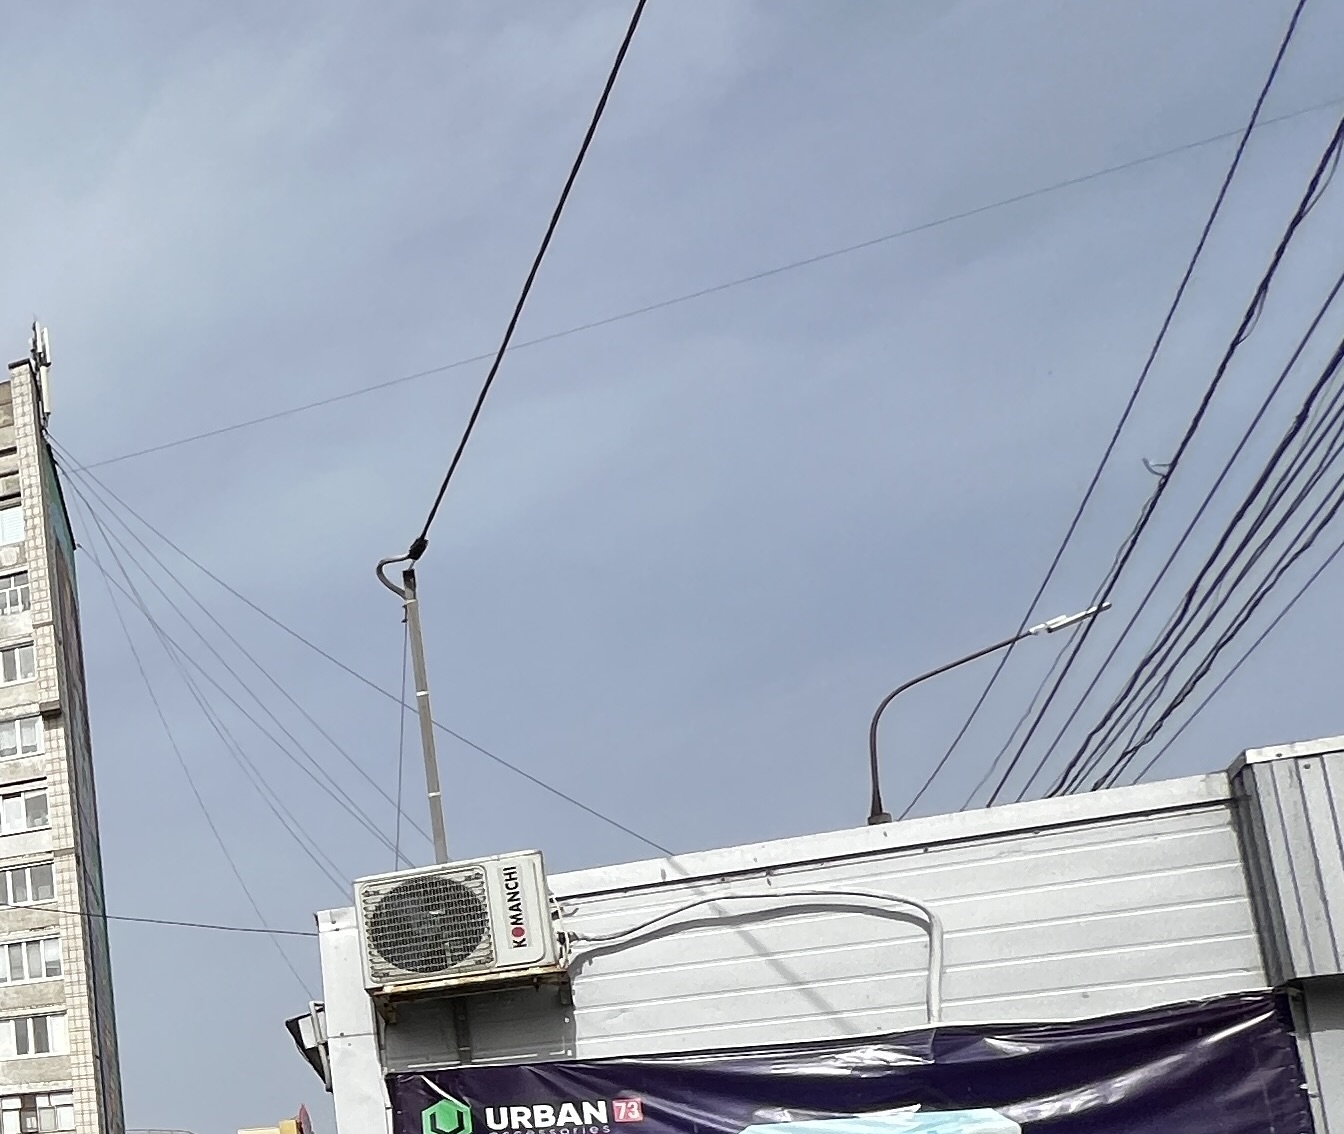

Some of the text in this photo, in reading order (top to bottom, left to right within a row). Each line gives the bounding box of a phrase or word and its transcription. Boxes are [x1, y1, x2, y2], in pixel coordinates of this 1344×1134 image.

[503, 865, 528, 949] KOMANCHI
[485, 1100, 642, 1130] URBAN 73
